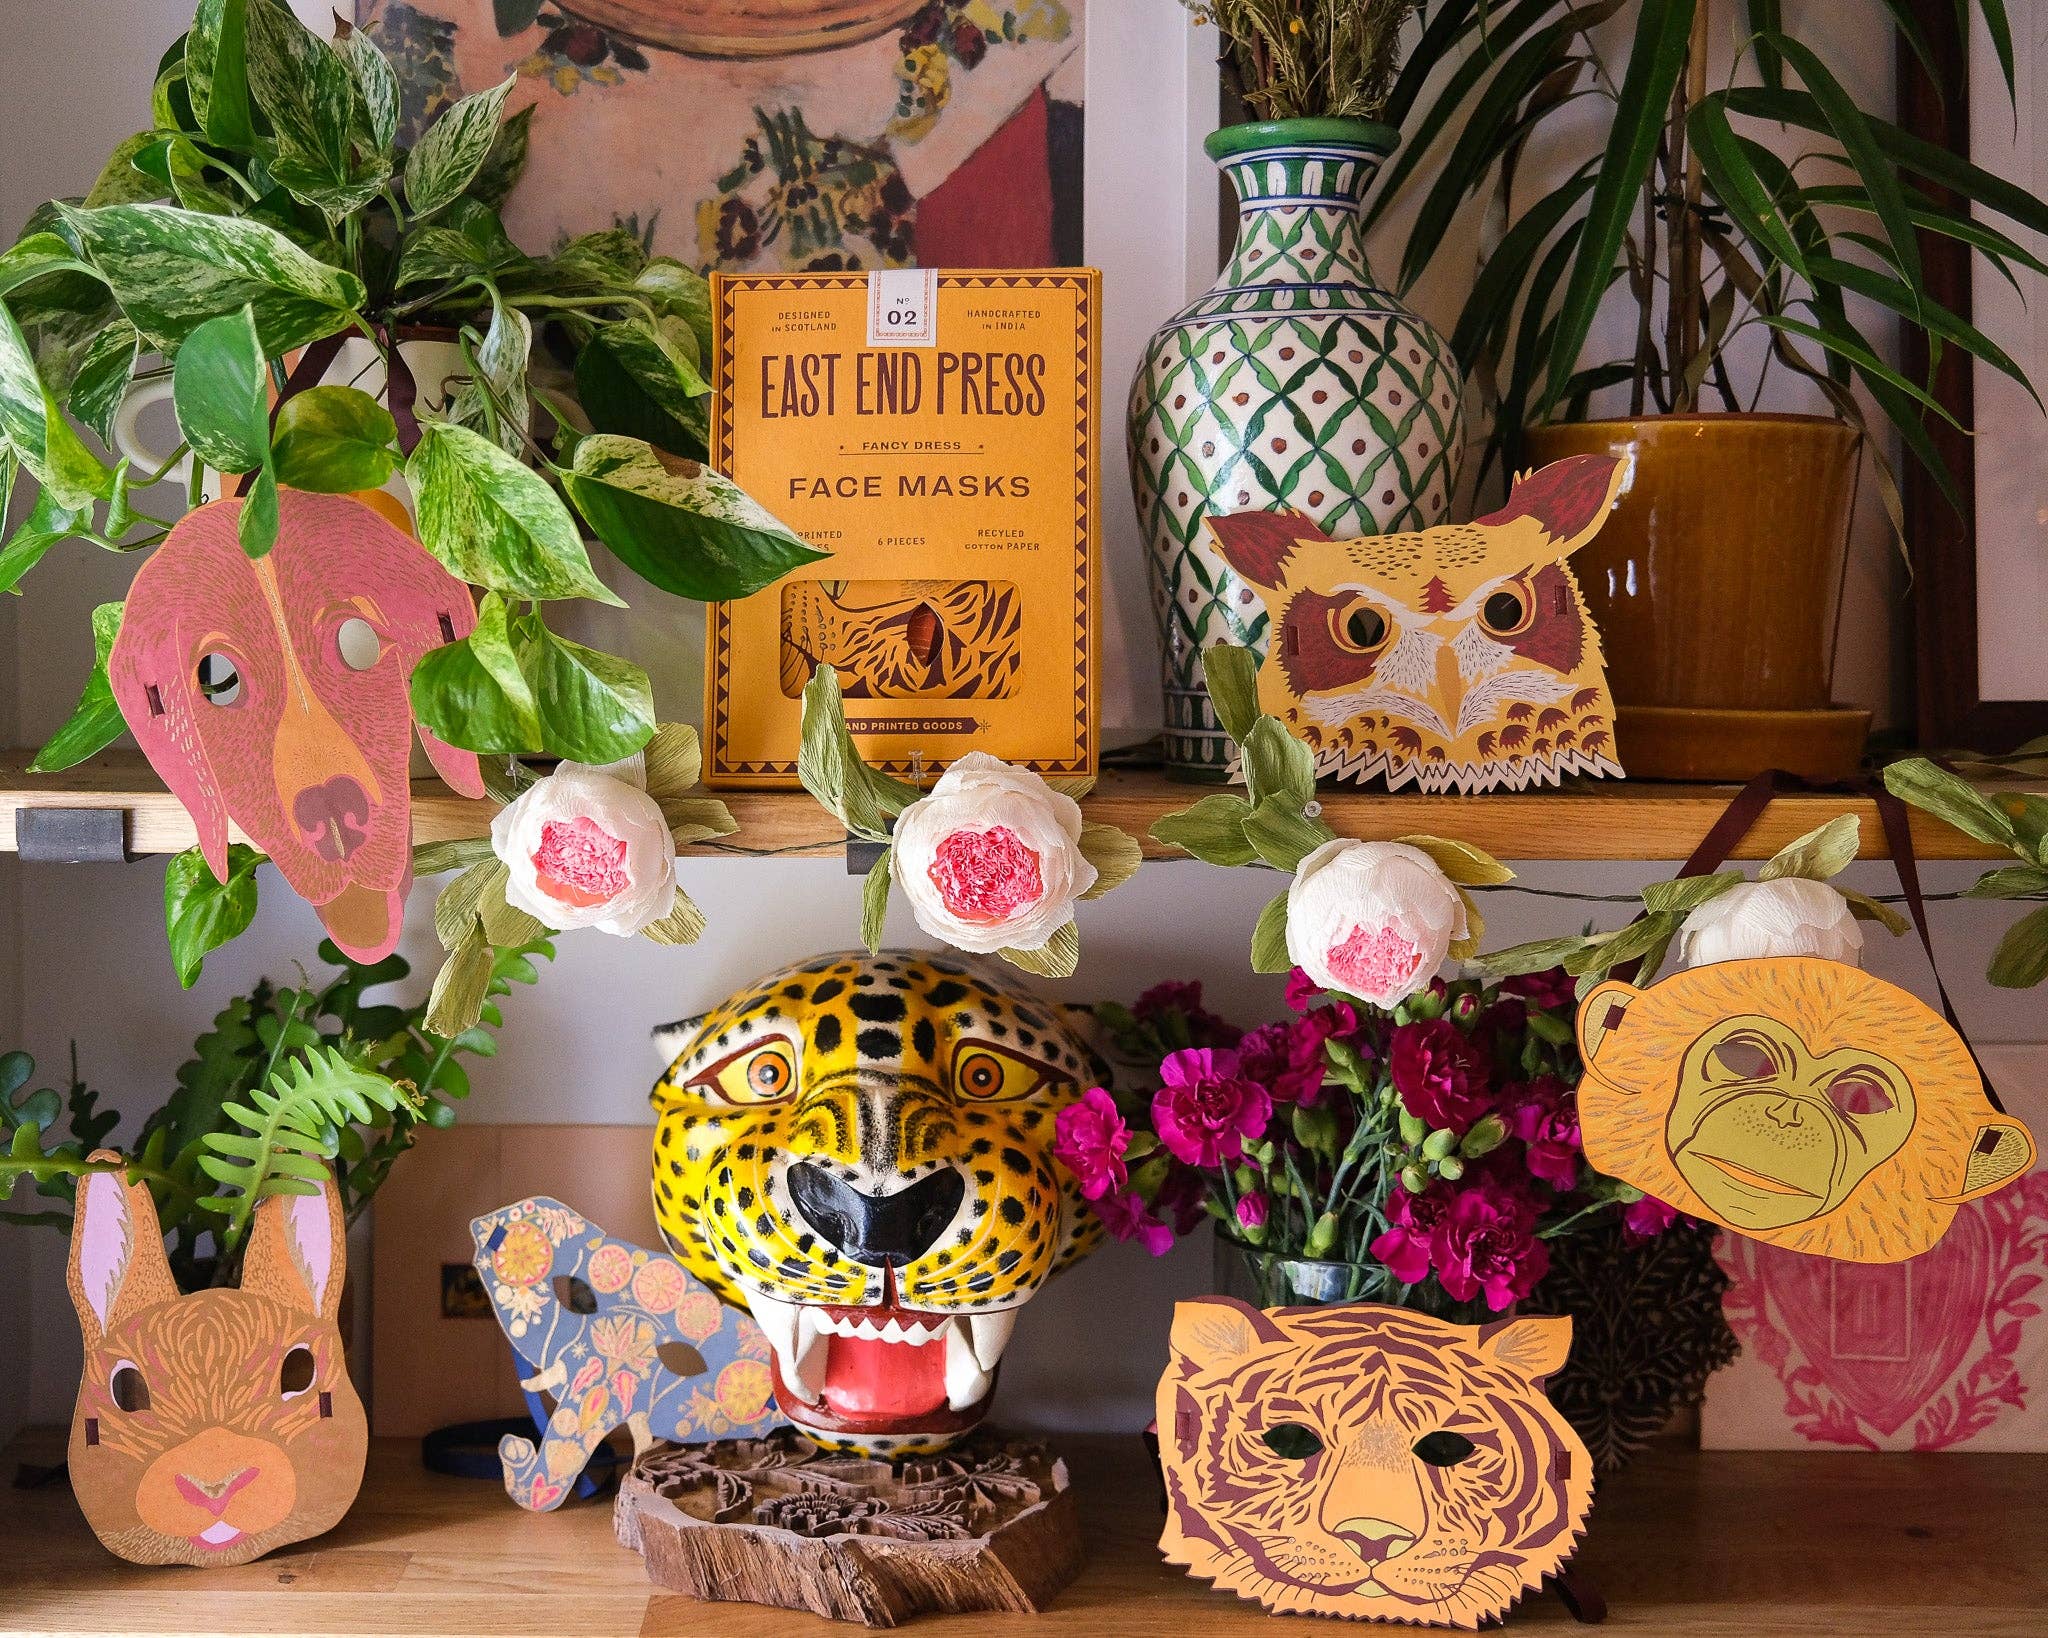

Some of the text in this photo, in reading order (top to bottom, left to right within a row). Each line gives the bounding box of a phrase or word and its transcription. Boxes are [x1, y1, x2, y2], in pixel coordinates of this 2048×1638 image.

[778, 311, 831, 320] DESIGNED
[887, 310, 917, 325] 02
[967, 309, 1041, 318] HANDCRAFTED
[784, 323, 837, 332] SCOTLAND
[995, 321, 1026, 330] INDIA
[761, 352, 1046, 418] EAST END PRESS
[862, 441, 961, 451] FANCY DRESS
[789, 476, 1031, 499] FACE MASKS
[977, 529, 1025, 538] RECYLED
[877, 537, 926, 546] 6 PIECES
[1007, 543, 1040, 551] PAPER
[845, 721, 963, 731] AND PRINTED GOODS
